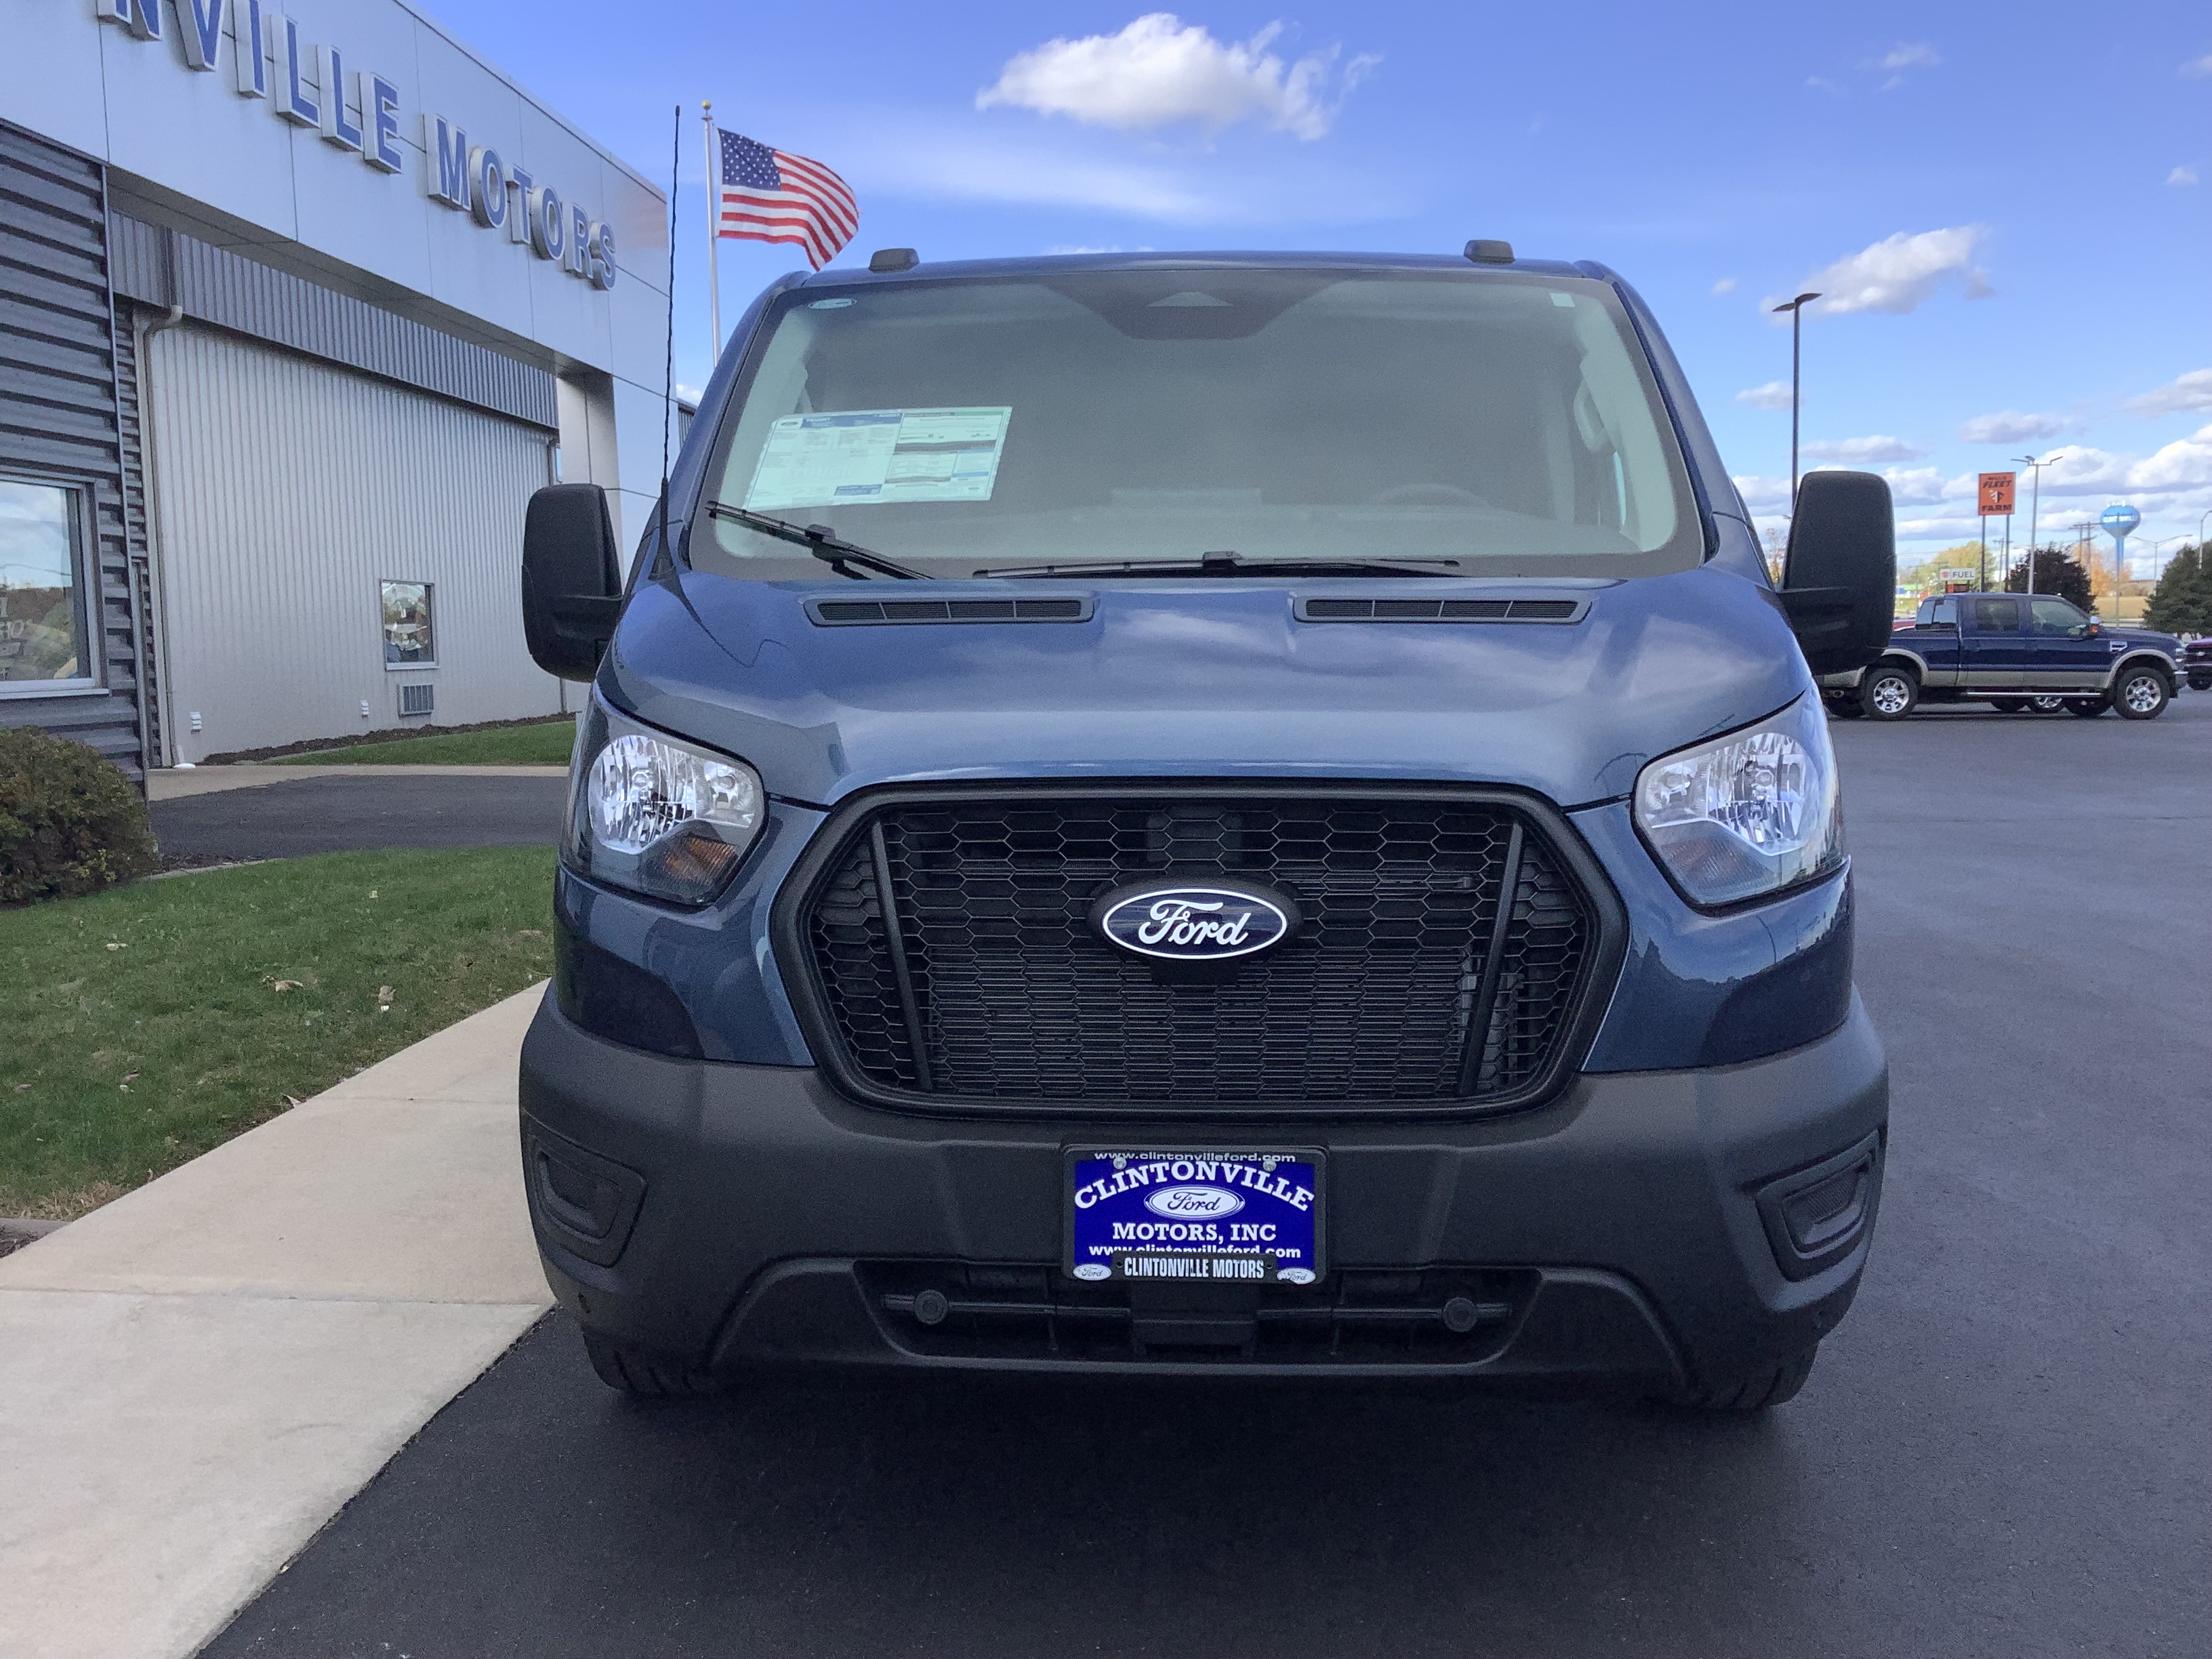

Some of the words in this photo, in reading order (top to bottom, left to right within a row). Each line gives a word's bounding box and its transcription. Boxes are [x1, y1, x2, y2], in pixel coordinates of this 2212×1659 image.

[424, 114, 616, 290] MOTORS
[1983, 480, 2012, 488] FLEET
[1139, 899, 1251, 945] Ford
[1075, 1161, 1314, 1212] CLINTONVILLE
[1167, 1191, 1221, 1211] Ford
[1113, 1223, 1223, 1244] MOTORS,
[1230, 1224, 1276, 1242] INC
[1082, 1267, 1103, 1277] Ford
[1124, 1257, 1209, 1278] CLINTONVILLE
[1213, 1259, 1264, 1279] MOTORS
